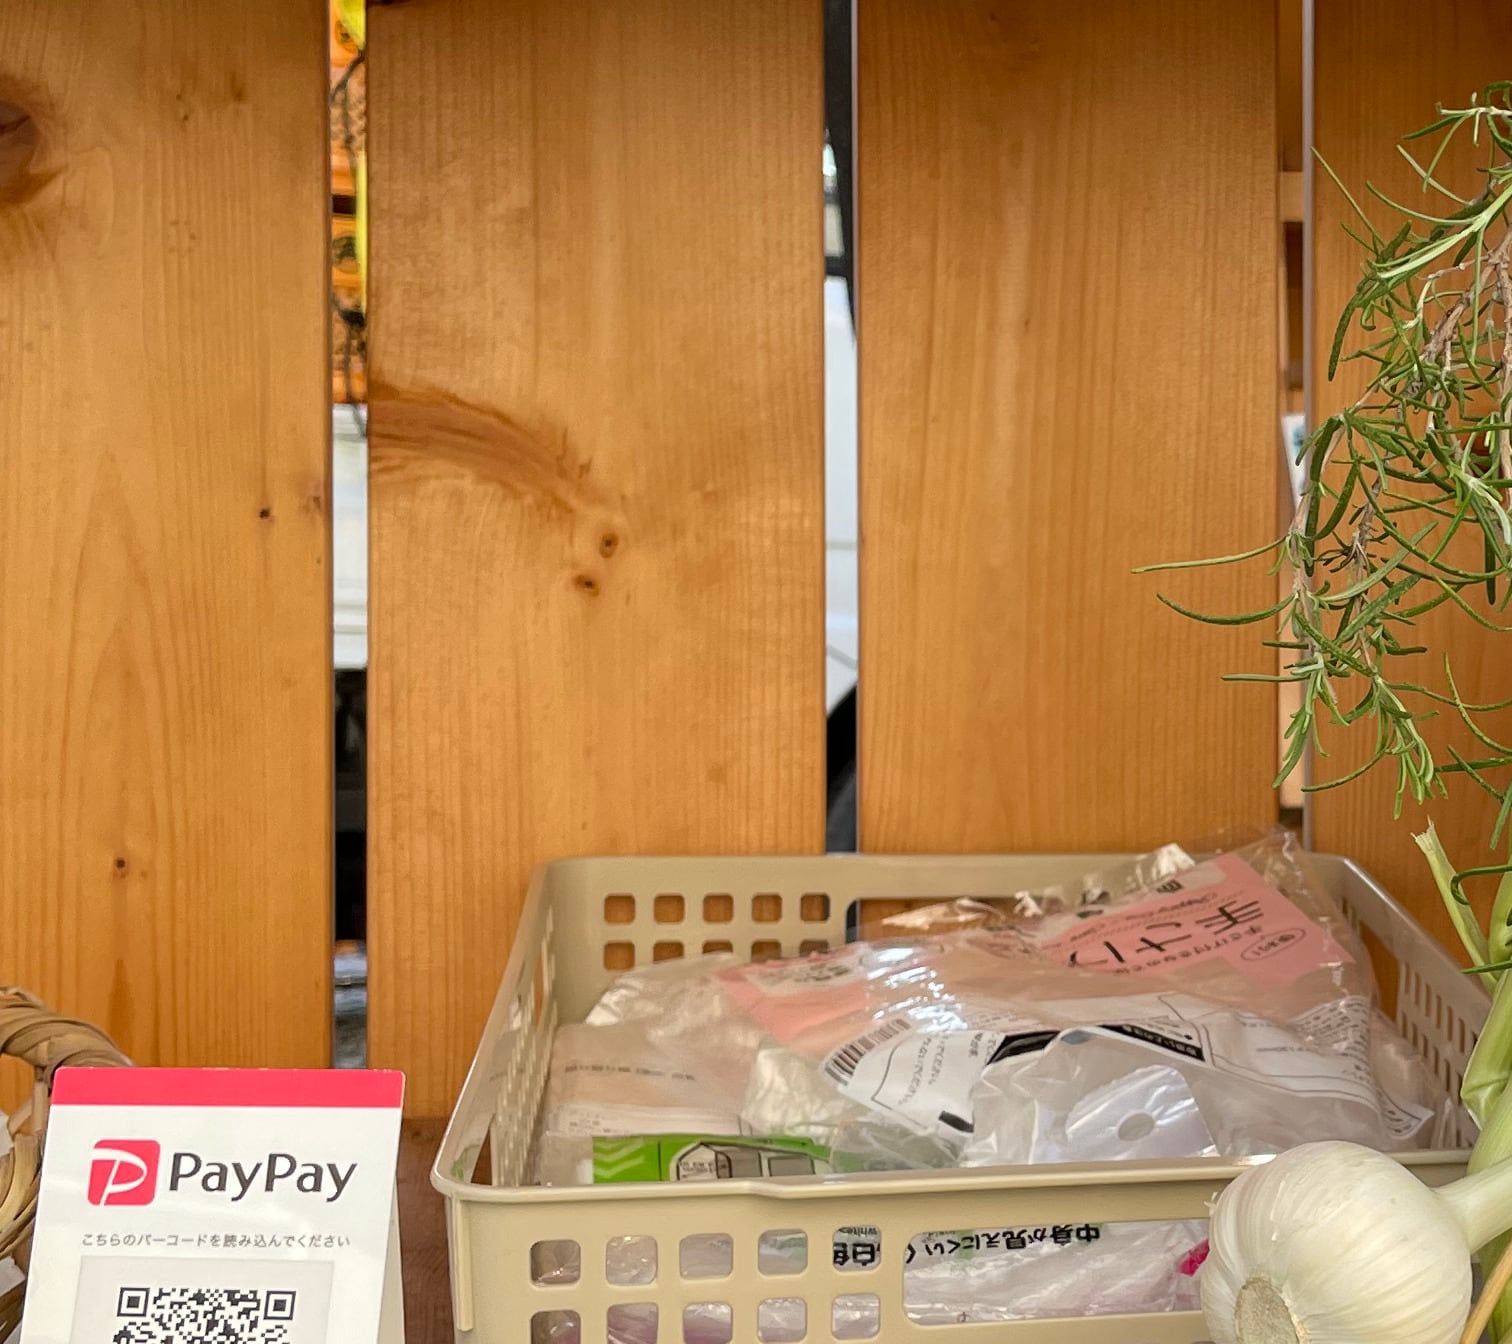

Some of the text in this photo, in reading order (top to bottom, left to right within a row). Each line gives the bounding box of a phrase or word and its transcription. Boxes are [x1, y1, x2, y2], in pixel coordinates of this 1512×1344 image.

[170, 1152, 357, 1202] PayPay
[82, 1233, 350, 1248] こちらのバーコードを読み込んでください
